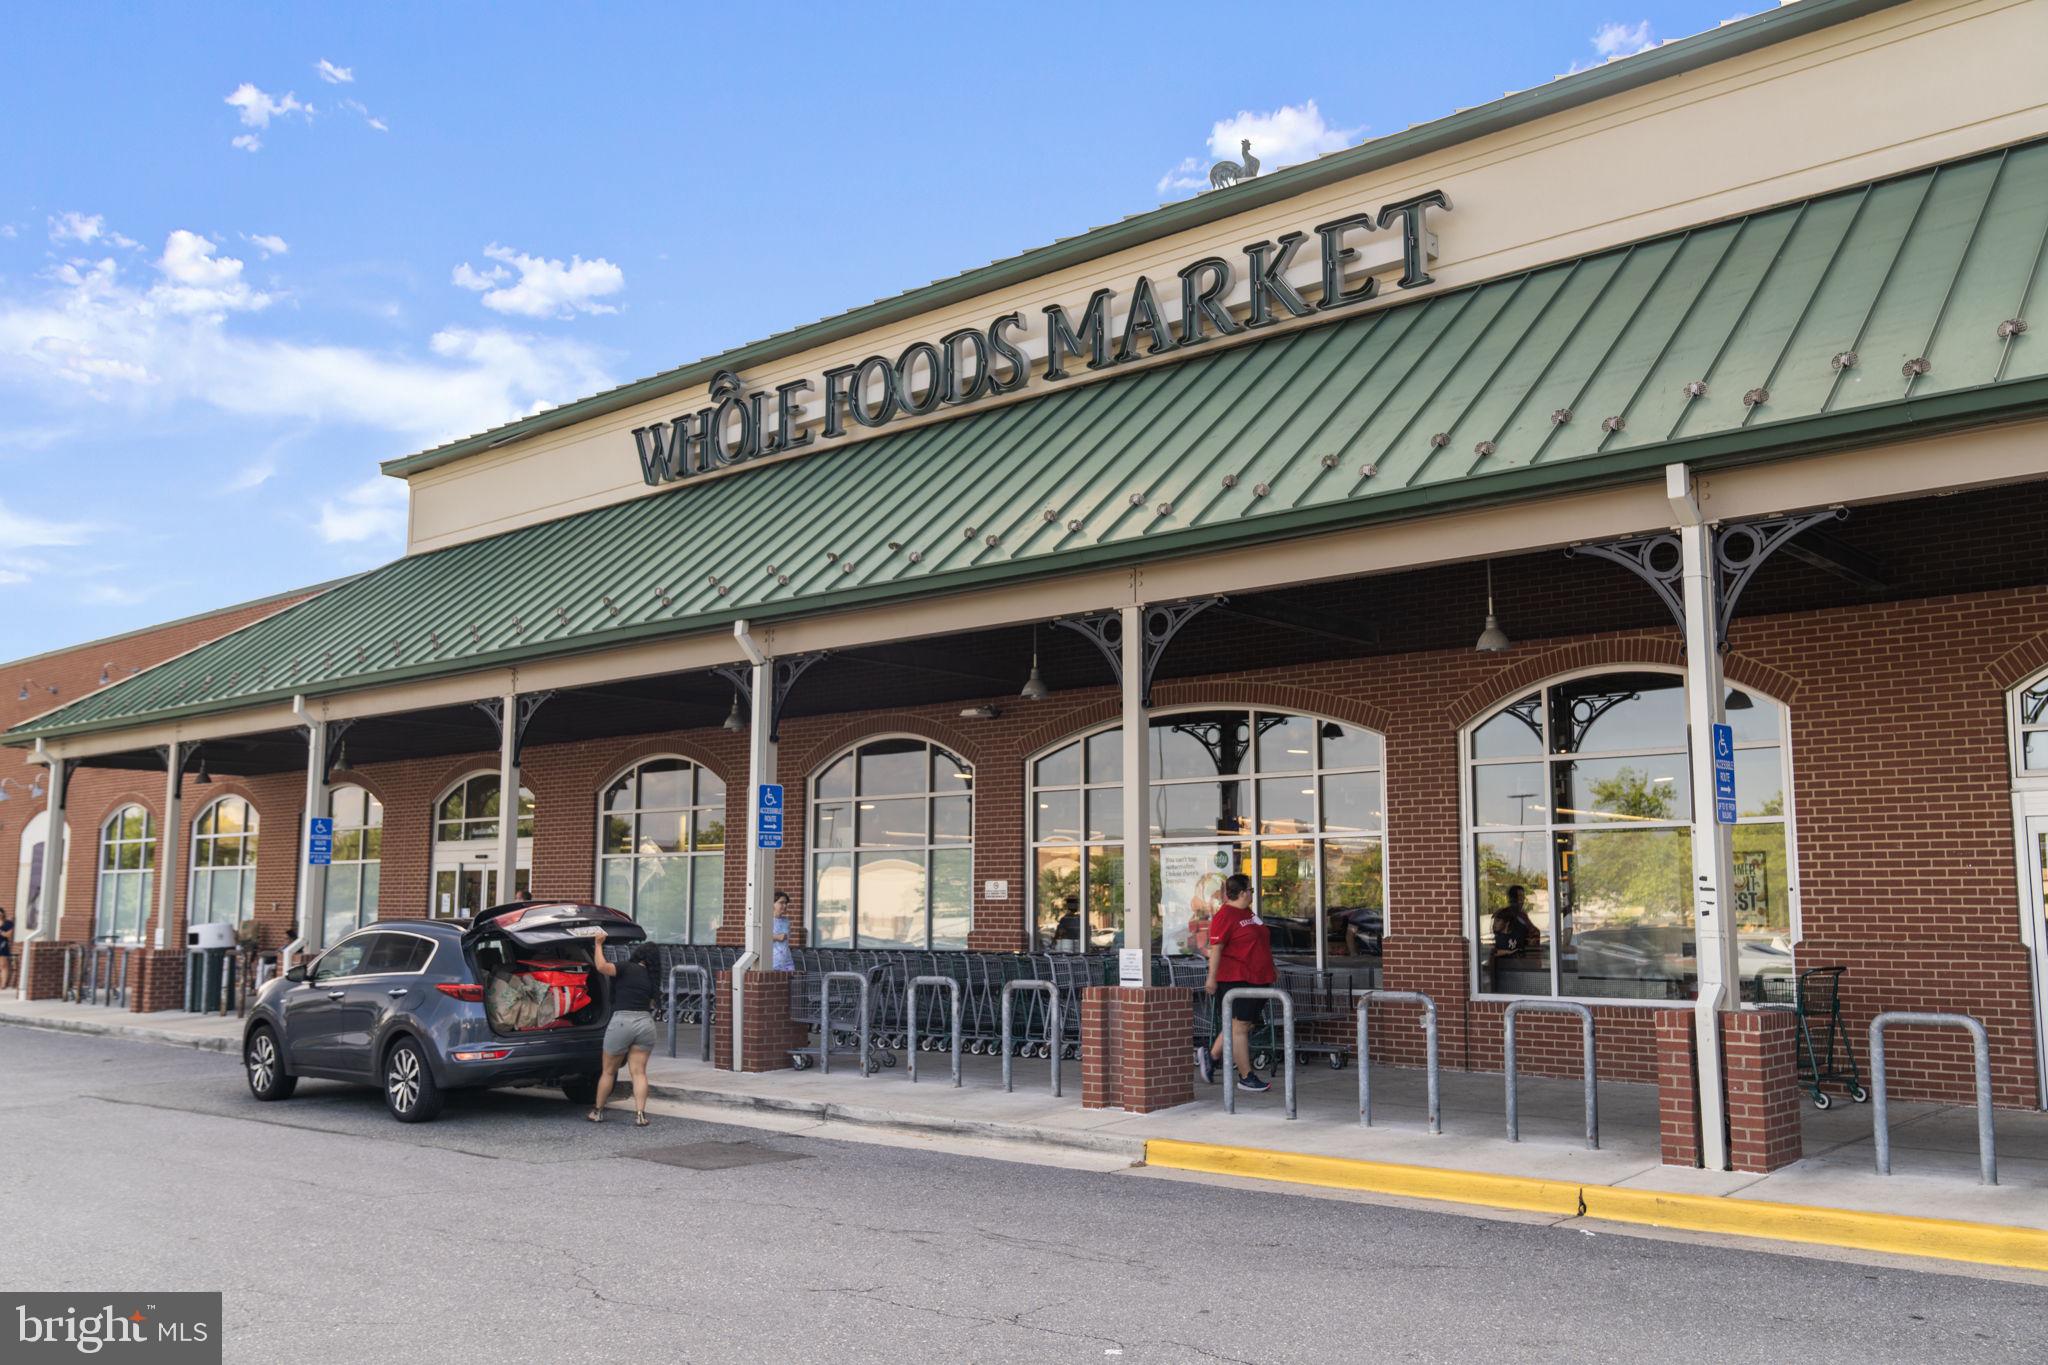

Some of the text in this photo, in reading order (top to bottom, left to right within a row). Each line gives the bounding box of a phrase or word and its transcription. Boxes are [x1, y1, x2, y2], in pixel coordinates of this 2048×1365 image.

[631, 189, 1453, 486] WHOLE FOODS MARKET
